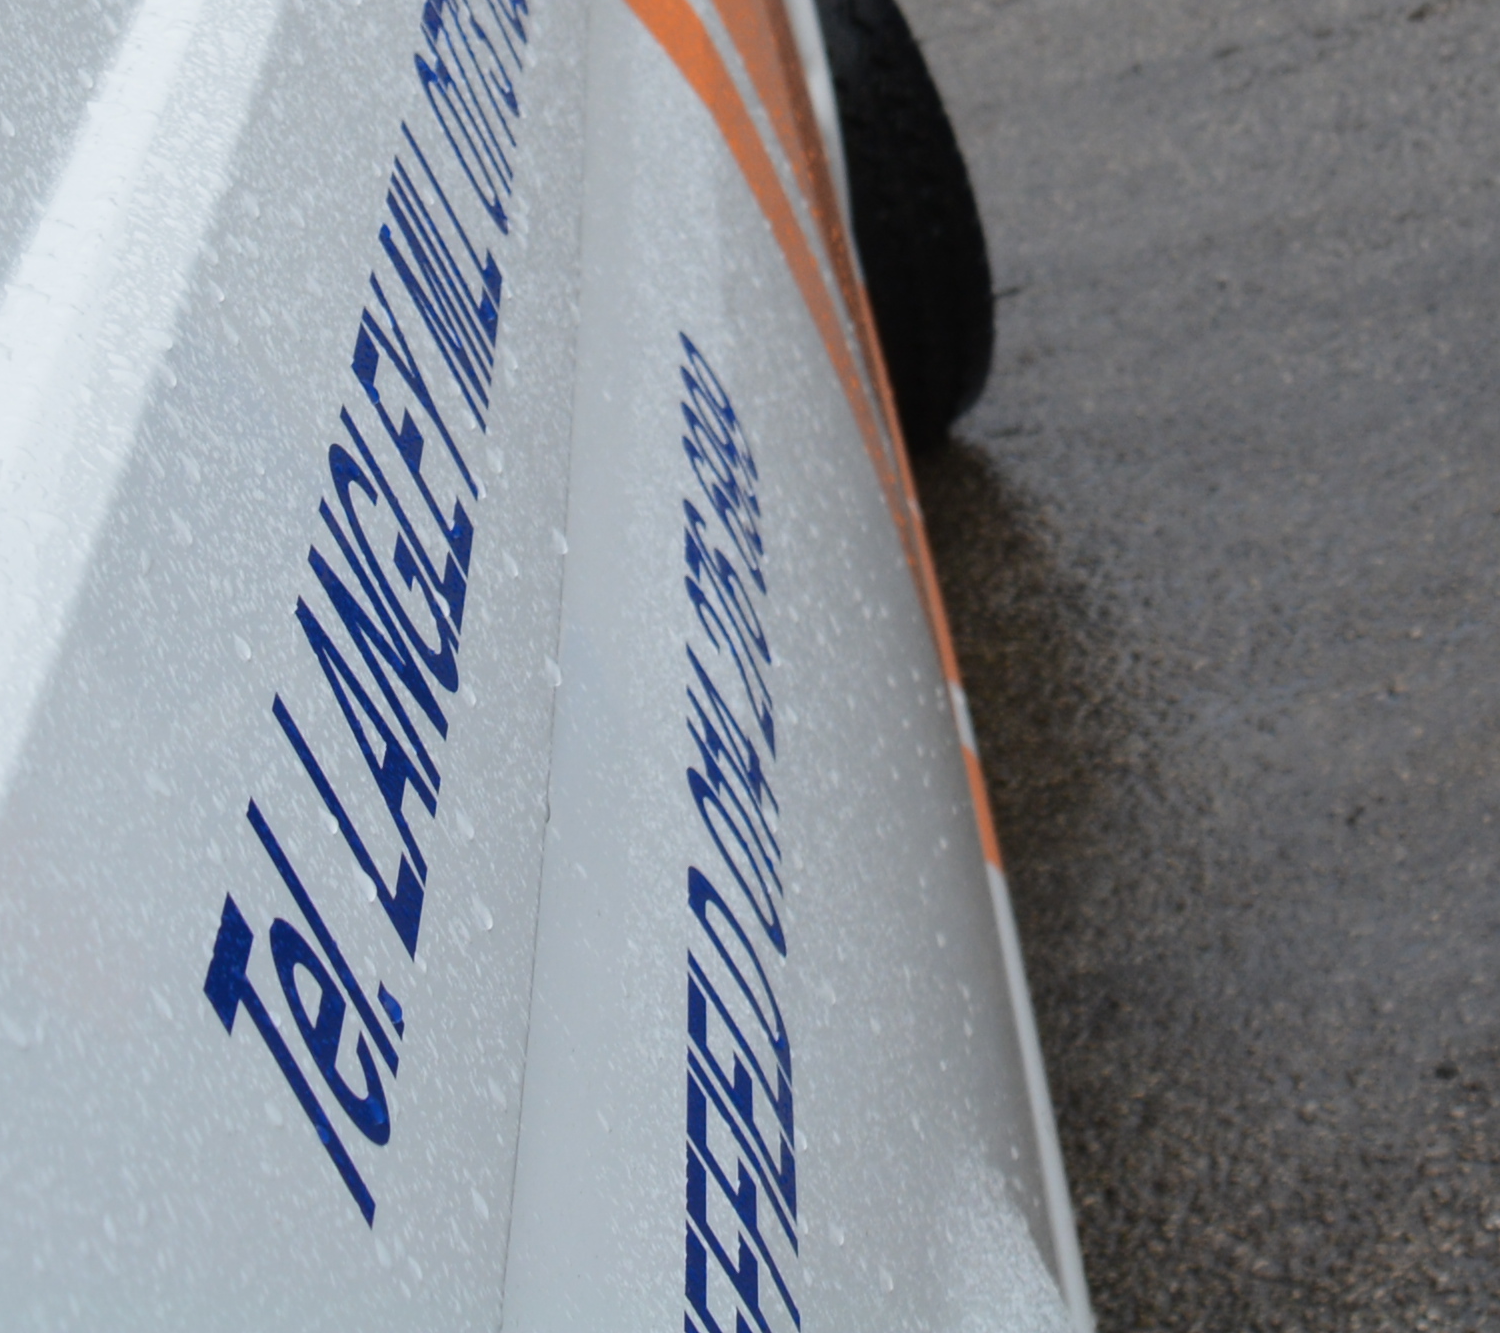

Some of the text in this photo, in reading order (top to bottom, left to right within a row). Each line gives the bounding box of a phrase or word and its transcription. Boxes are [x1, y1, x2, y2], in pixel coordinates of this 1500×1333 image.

[379, 120, 503, 435] MILL
[273, 271, 479, 963] LANGLEY
[679, 331, 801, 1333] FFIELD 0114 276 6999
[203, 797, 405, 1229] Tel.
